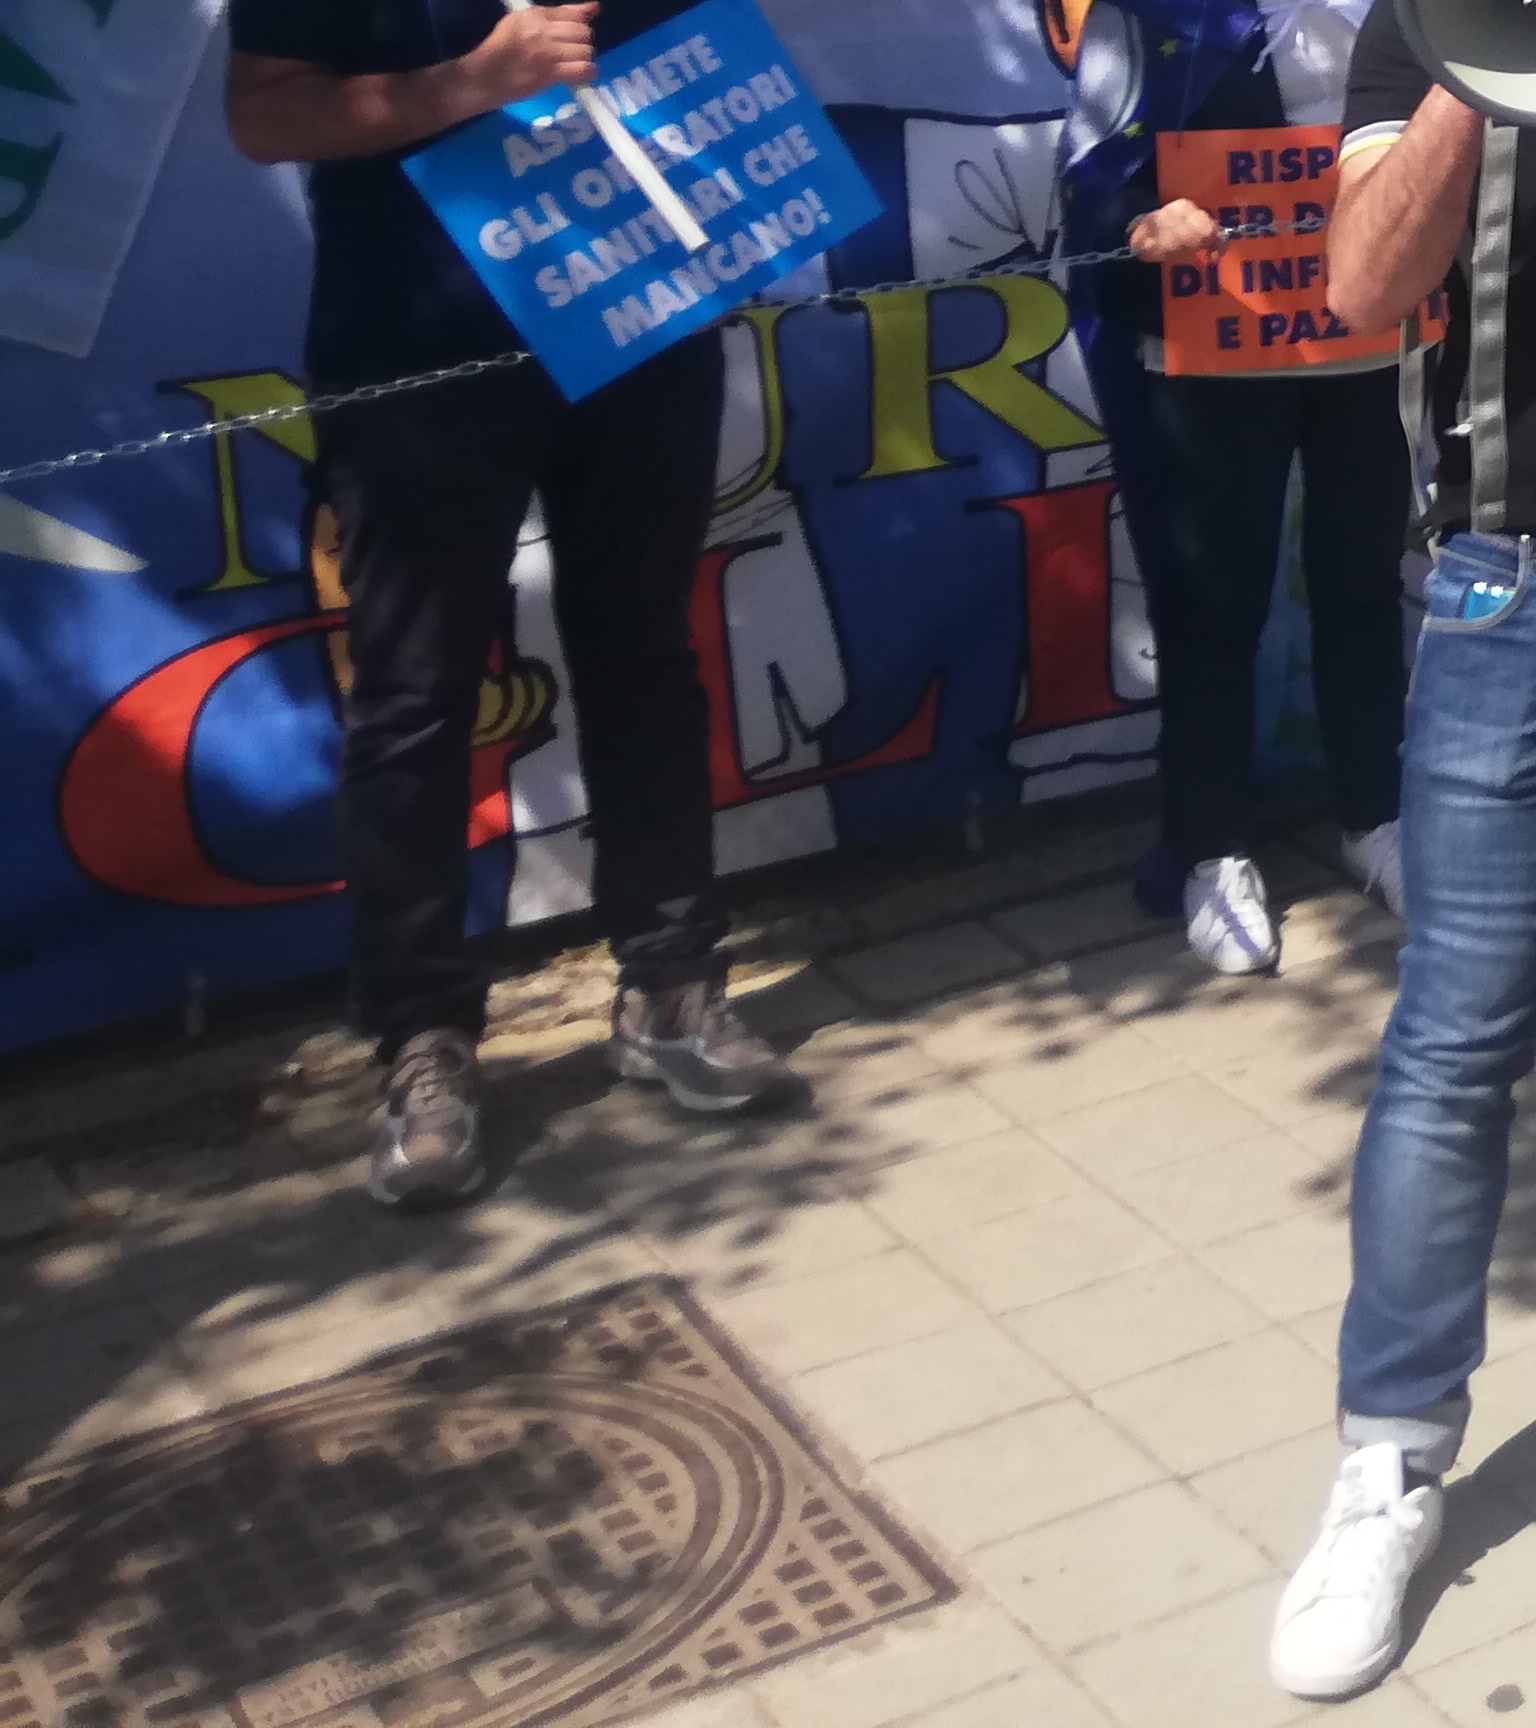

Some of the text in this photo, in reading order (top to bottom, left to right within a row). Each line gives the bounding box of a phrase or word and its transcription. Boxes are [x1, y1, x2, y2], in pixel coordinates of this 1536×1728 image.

[1226, 145, 1335, 186] RISP
[479, 191, 572, 261] GLI
[535, 123, 819, 308] SANITRI CHE
[602, 186, 833, 347] MANCANO!
[1170, 263, 1219, 298] DI
[1216, 315, 1241, 351] E
